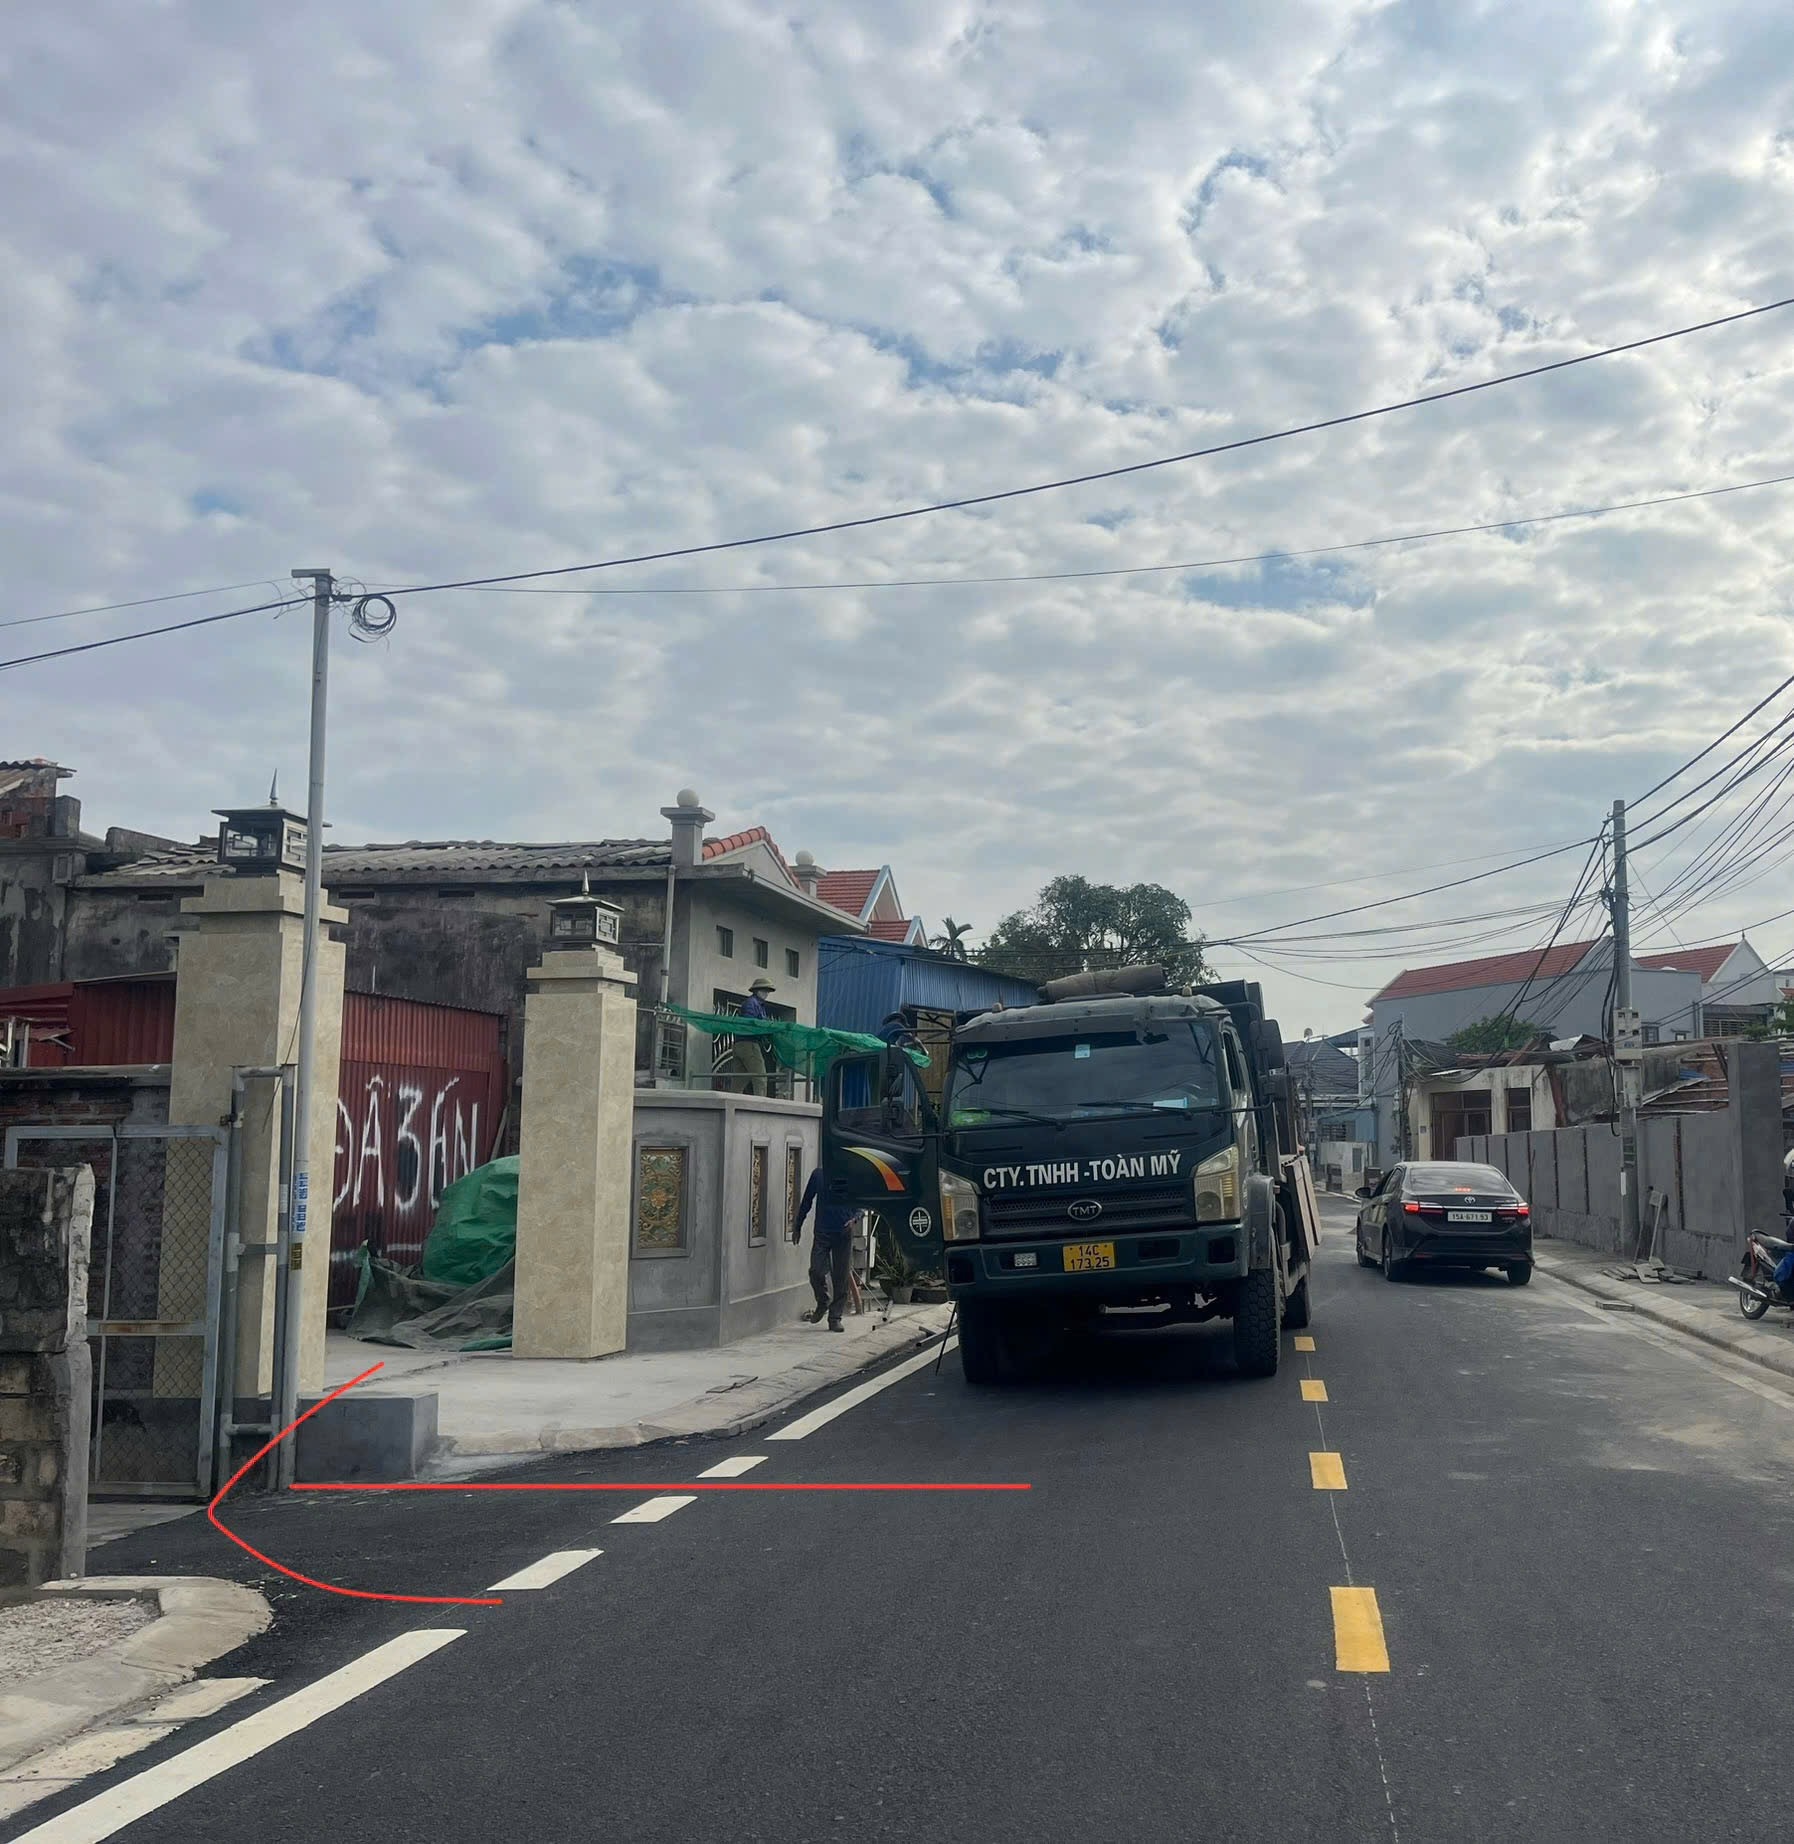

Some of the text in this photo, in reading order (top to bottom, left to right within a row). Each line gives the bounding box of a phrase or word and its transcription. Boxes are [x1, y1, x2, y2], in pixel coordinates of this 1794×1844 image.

[1150, 1149, 1182, 1176] MỸ
[1072, 1205, 1097, 1216] TMT
[1079, 1244, 1100, 1257] 14C
